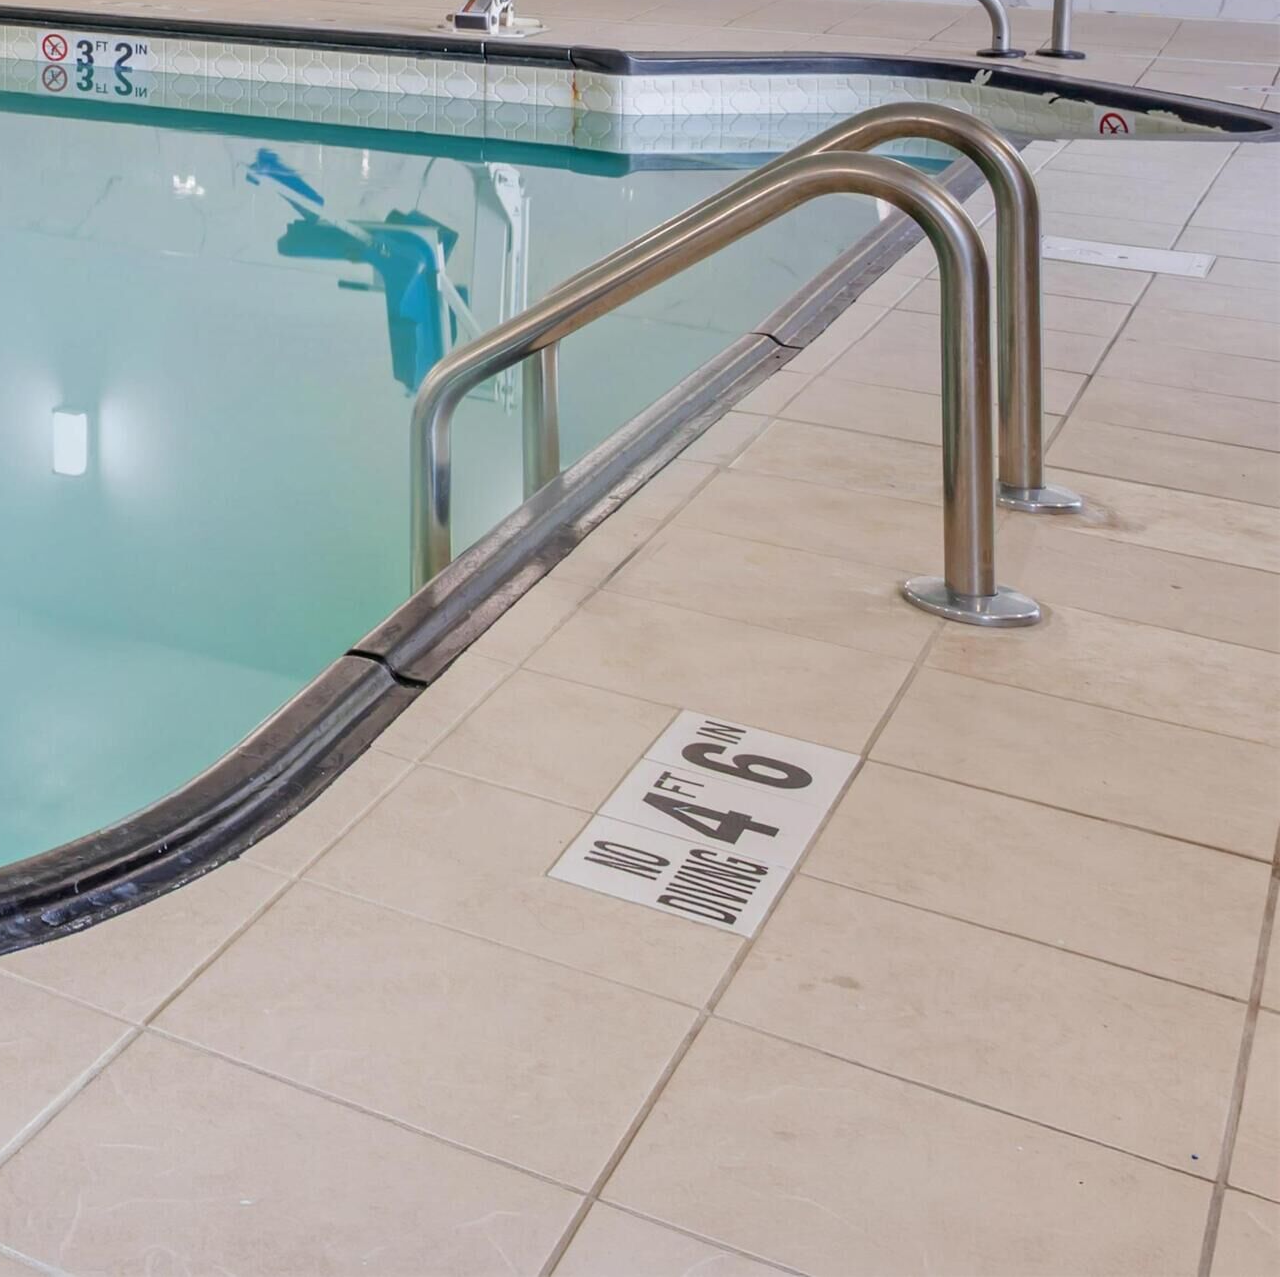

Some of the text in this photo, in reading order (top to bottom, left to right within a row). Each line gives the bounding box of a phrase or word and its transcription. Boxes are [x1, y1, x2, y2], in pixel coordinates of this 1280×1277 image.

[76, 39, 148, 70] 3 FT 2 IN
[642, 720, 813, 845] 4 FT 6 IN
[583, 840, 671, 881] NO
[656, 848, 769, 925] DIVING
